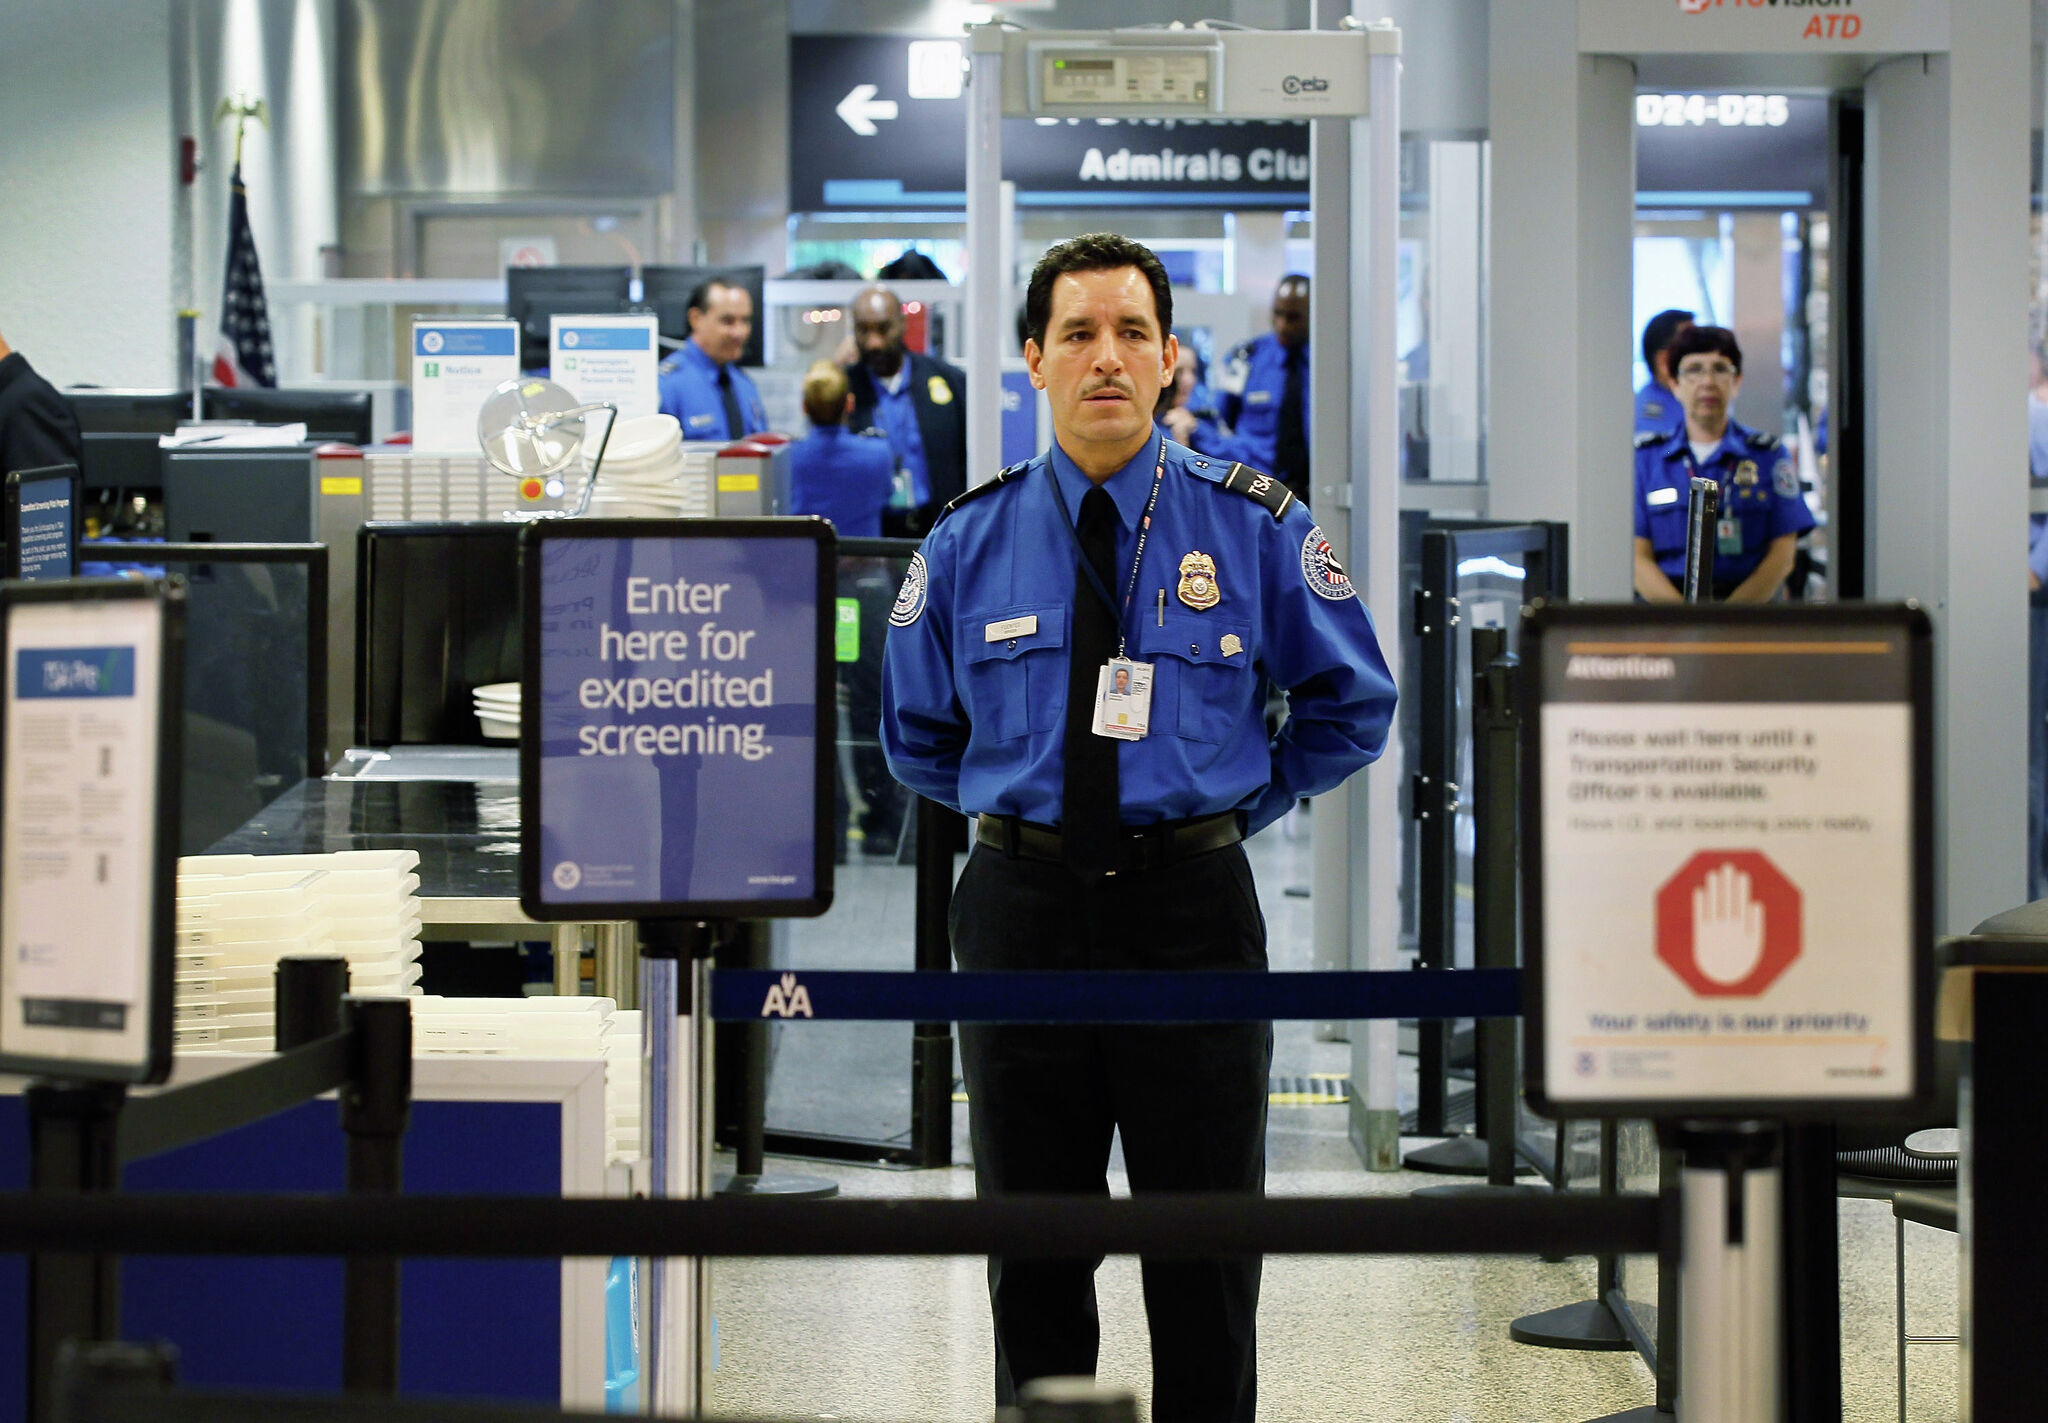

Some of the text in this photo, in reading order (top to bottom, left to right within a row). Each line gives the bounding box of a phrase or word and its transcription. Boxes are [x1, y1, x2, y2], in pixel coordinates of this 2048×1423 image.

[1803, 13, 1862, 40] ATD
[1636, 94, 1790, 126] D24-D25
[1079, 147, 1241, 182] Admirals
[1248, 474, 1275, 496] TSA
[626, 577, 731, 614] Enter
[600, 622, 755, 661] here for
[1566, 656, 1675, 680] Attention
[579, 668, 773, 715] expedited
[579, 715, 773, 761] screening.
[761, 974, 814, 1018] AA
[1588, 1014, 1636, 1031] Your
[1645, 1013, 1711, 1034] safety
[1783, 1013, 1868, 1034] priority
